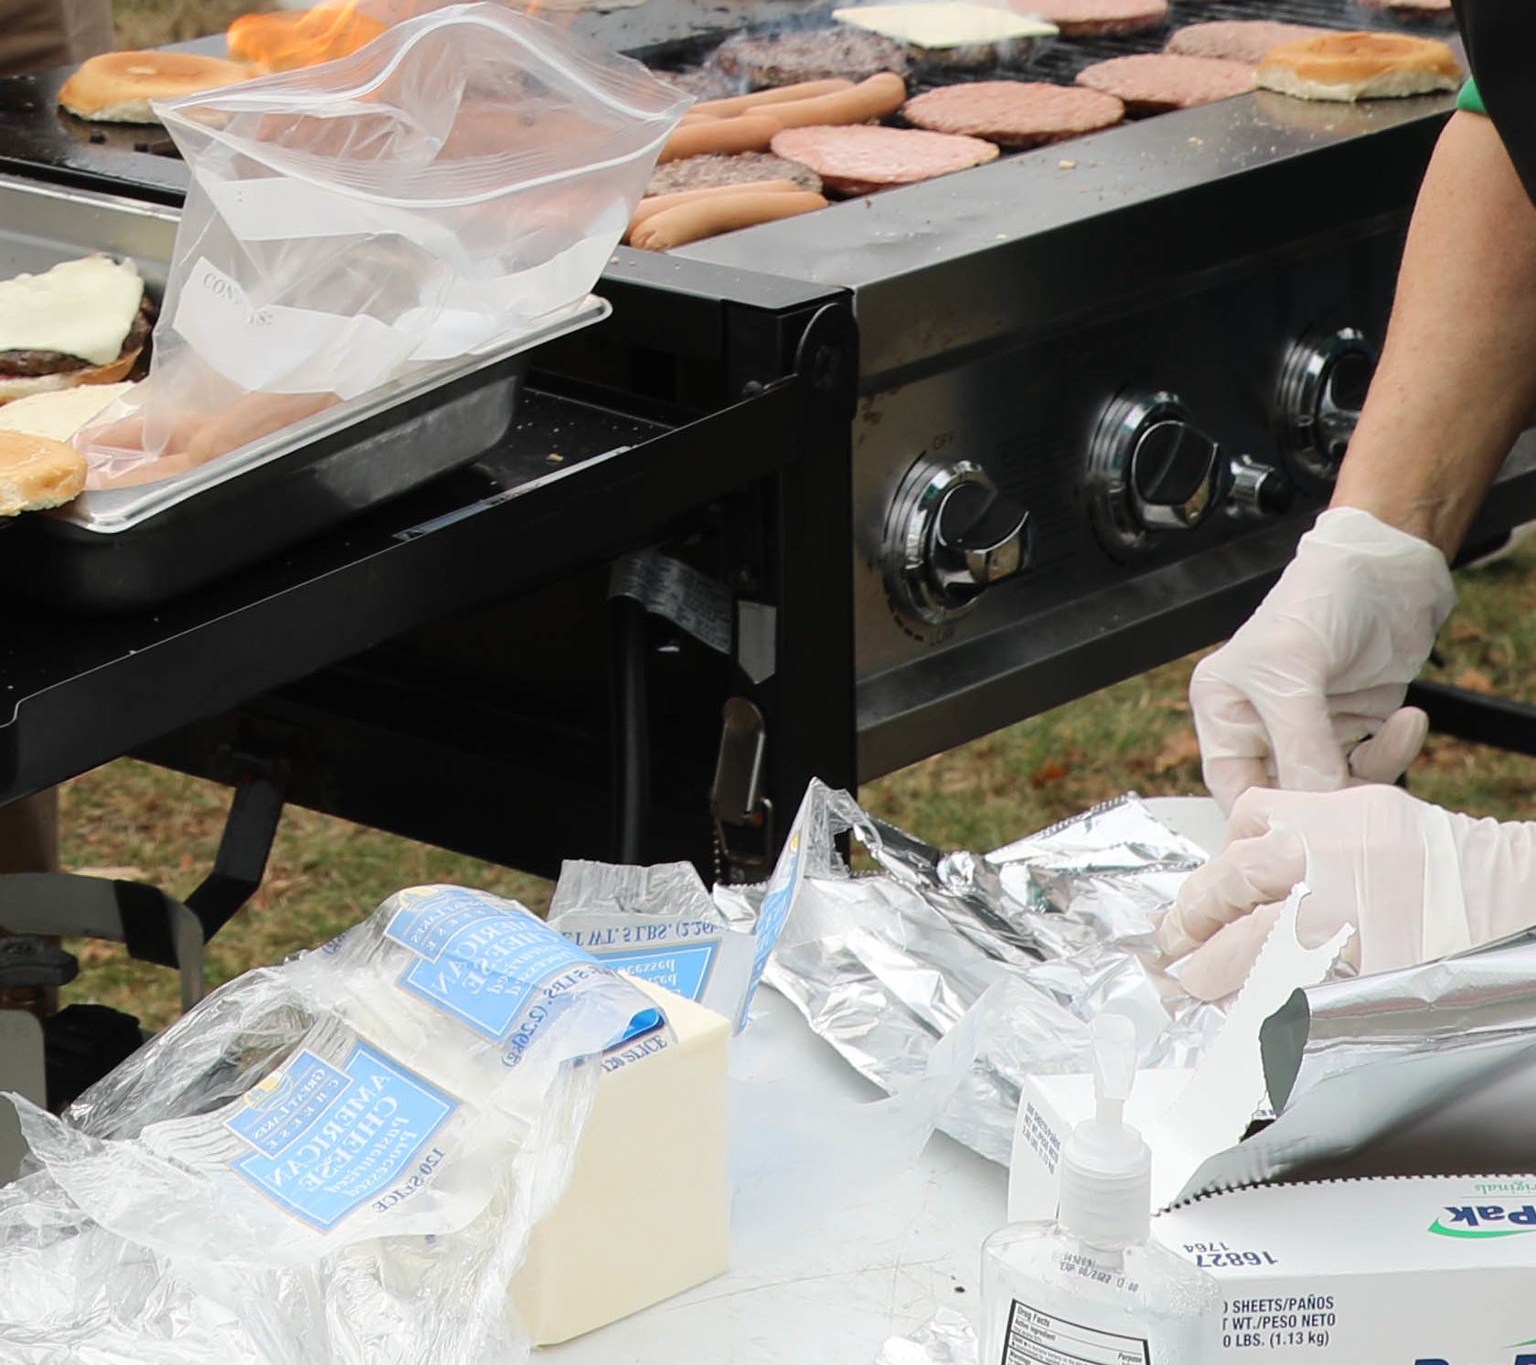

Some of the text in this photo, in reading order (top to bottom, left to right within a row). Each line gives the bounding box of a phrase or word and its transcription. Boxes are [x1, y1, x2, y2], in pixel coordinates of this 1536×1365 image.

[623, 1034, 669, 1063] SLICE
[1183, 1241, 1230, 1254] 1764
[1195, 1250, 1280, 1268] 16827
[1232, 1293, 1335, 1314] SHEETS/PAÑOS
[1232, 1314, 1298, 1330] WT./PESO
[1301, 1312, 1337, 1328] NETO
[1235, 1332, 1266, 1348] LBS.
[1269, 1331, 1305, 1349] (1.13
[1307, 1329, 1330, 1347] kg)
